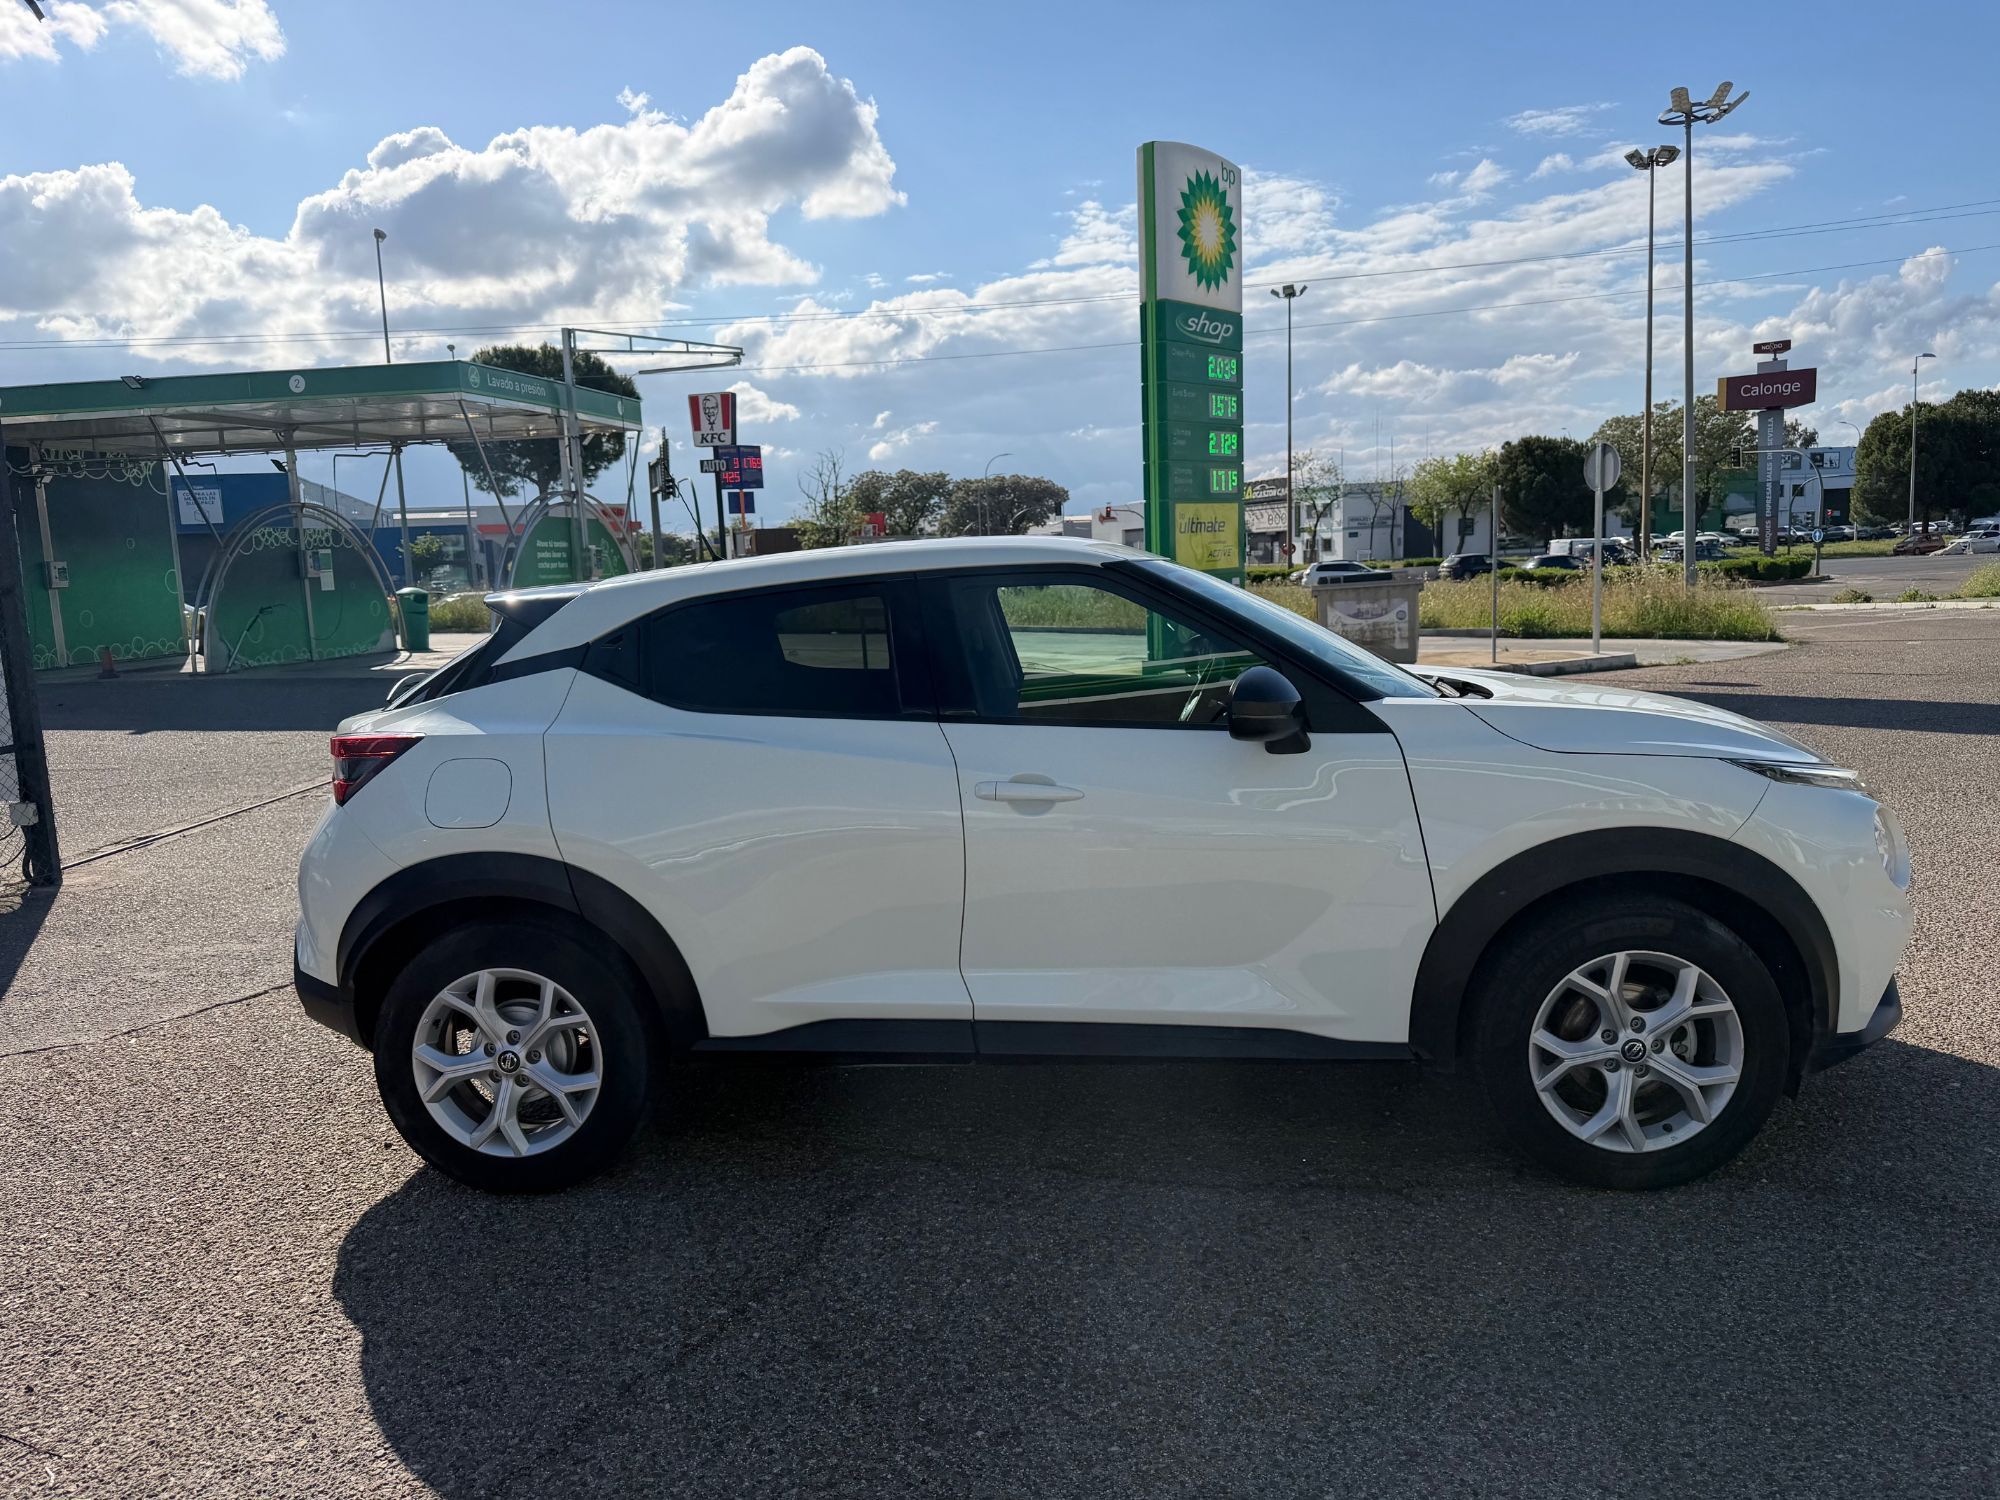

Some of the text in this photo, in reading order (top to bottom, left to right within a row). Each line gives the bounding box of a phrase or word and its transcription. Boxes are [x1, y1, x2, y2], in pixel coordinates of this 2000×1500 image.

[1221, 161, 1236, 188] bp
[1186, 312, 1233, 343] shop
[294, 378, 301, 389] 2
[487, 373, 546, 397] Lavado a presión
[1740, 381, 1801, 397] Calonge
[700, 432, 726, 444] KFC
[702, 460, 727, 472] AUTO
[1765, 461, 1773, 518] EMPRESARIALES
[1179, 516, 1226, 534] ultimate
[1764, 520, 1772, 552] PARQUES
[1207, 548, 1233, 558] ACTIVE
